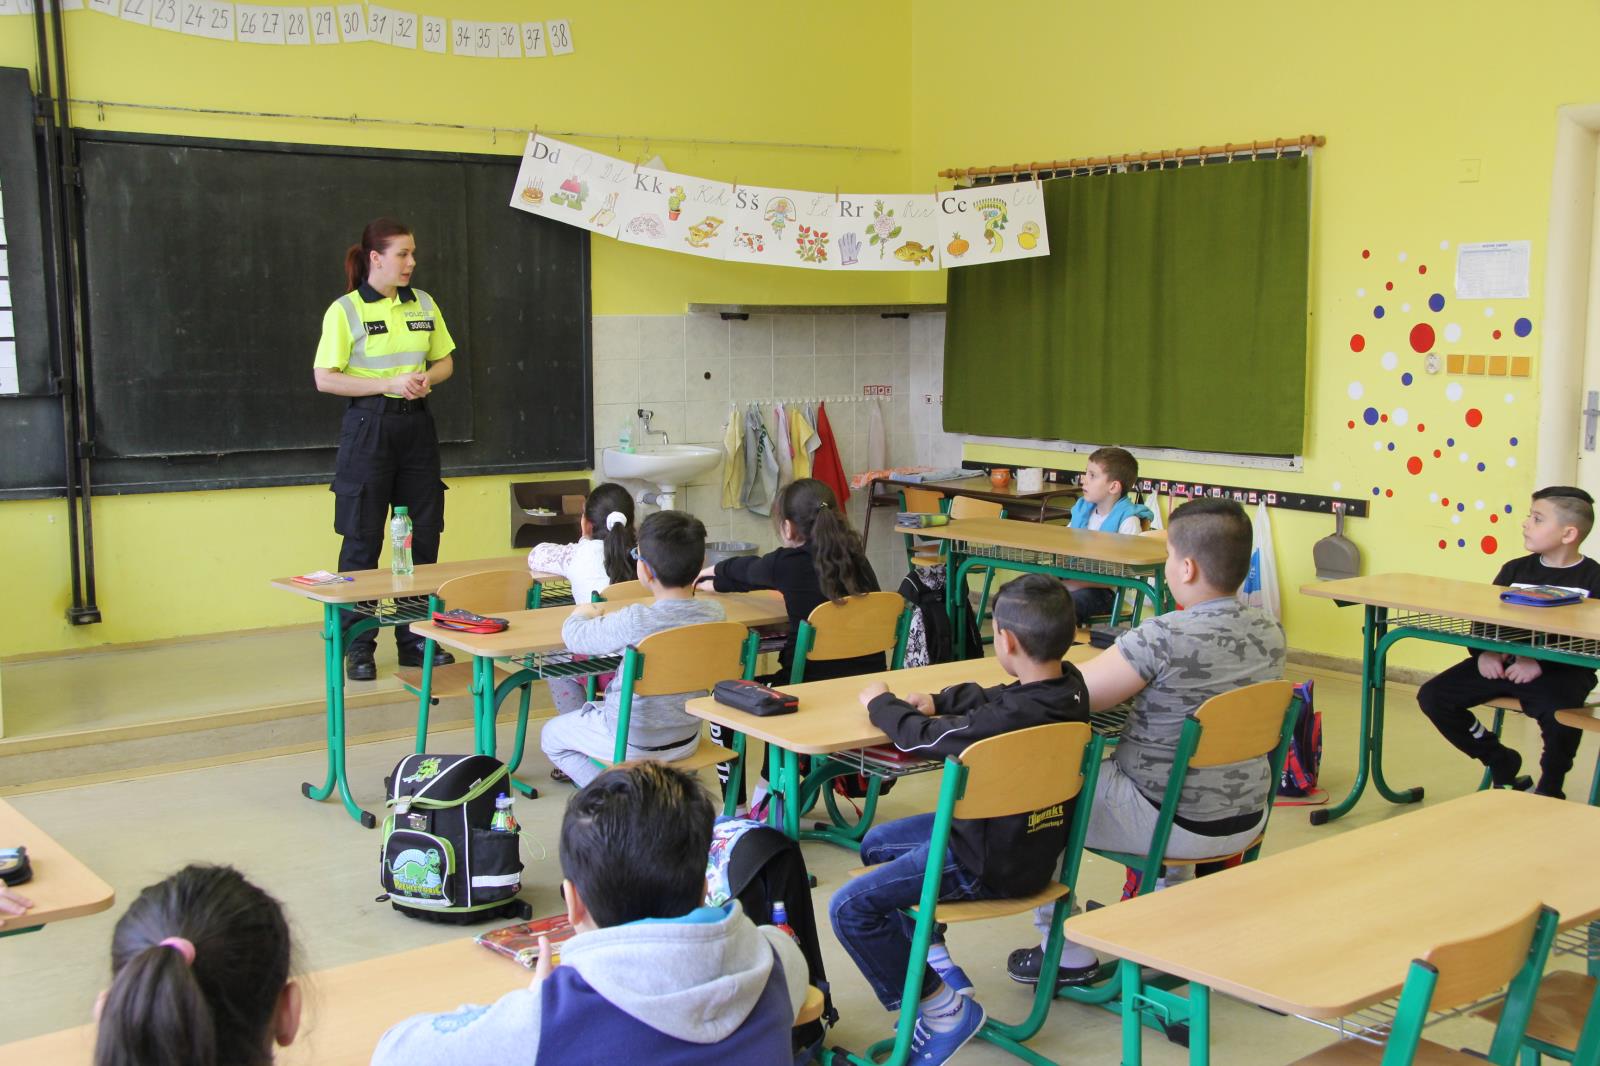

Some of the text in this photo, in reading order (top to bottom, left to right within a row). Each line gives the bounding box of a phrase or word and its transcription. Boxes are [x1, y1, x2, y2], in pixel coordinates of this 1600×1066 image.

[154, 0, 177, 24] 23
[184, 4, 206, 28] 24
[210, 7, 229, 29] 25
[240, 13, 256, 34] 26
[262, 12, 279, 34] 27
[288, 14, 304, 35] 28
[315, 11, 332, 35] 29
[343, 12, 360, 34] 30
[369, 14, 387, 34] 31
[394, 17, 413, 38] 32
[424, 22, 441, 43] 33
[455, 26, 472, 47] 34
[476, 28, 492, 49] 35
[500, 26, 515, 46] 36
[525, 28, 541, 50] 37
[551, 23, 568, 48] 38
[531, 141, 561, 165] Dd
[635, 173, 663, 195] Kk
[735, 189, 760, 211] Šš
[839, 200, 865, 218] Rr
[941, 197, 967, 215] Cc
